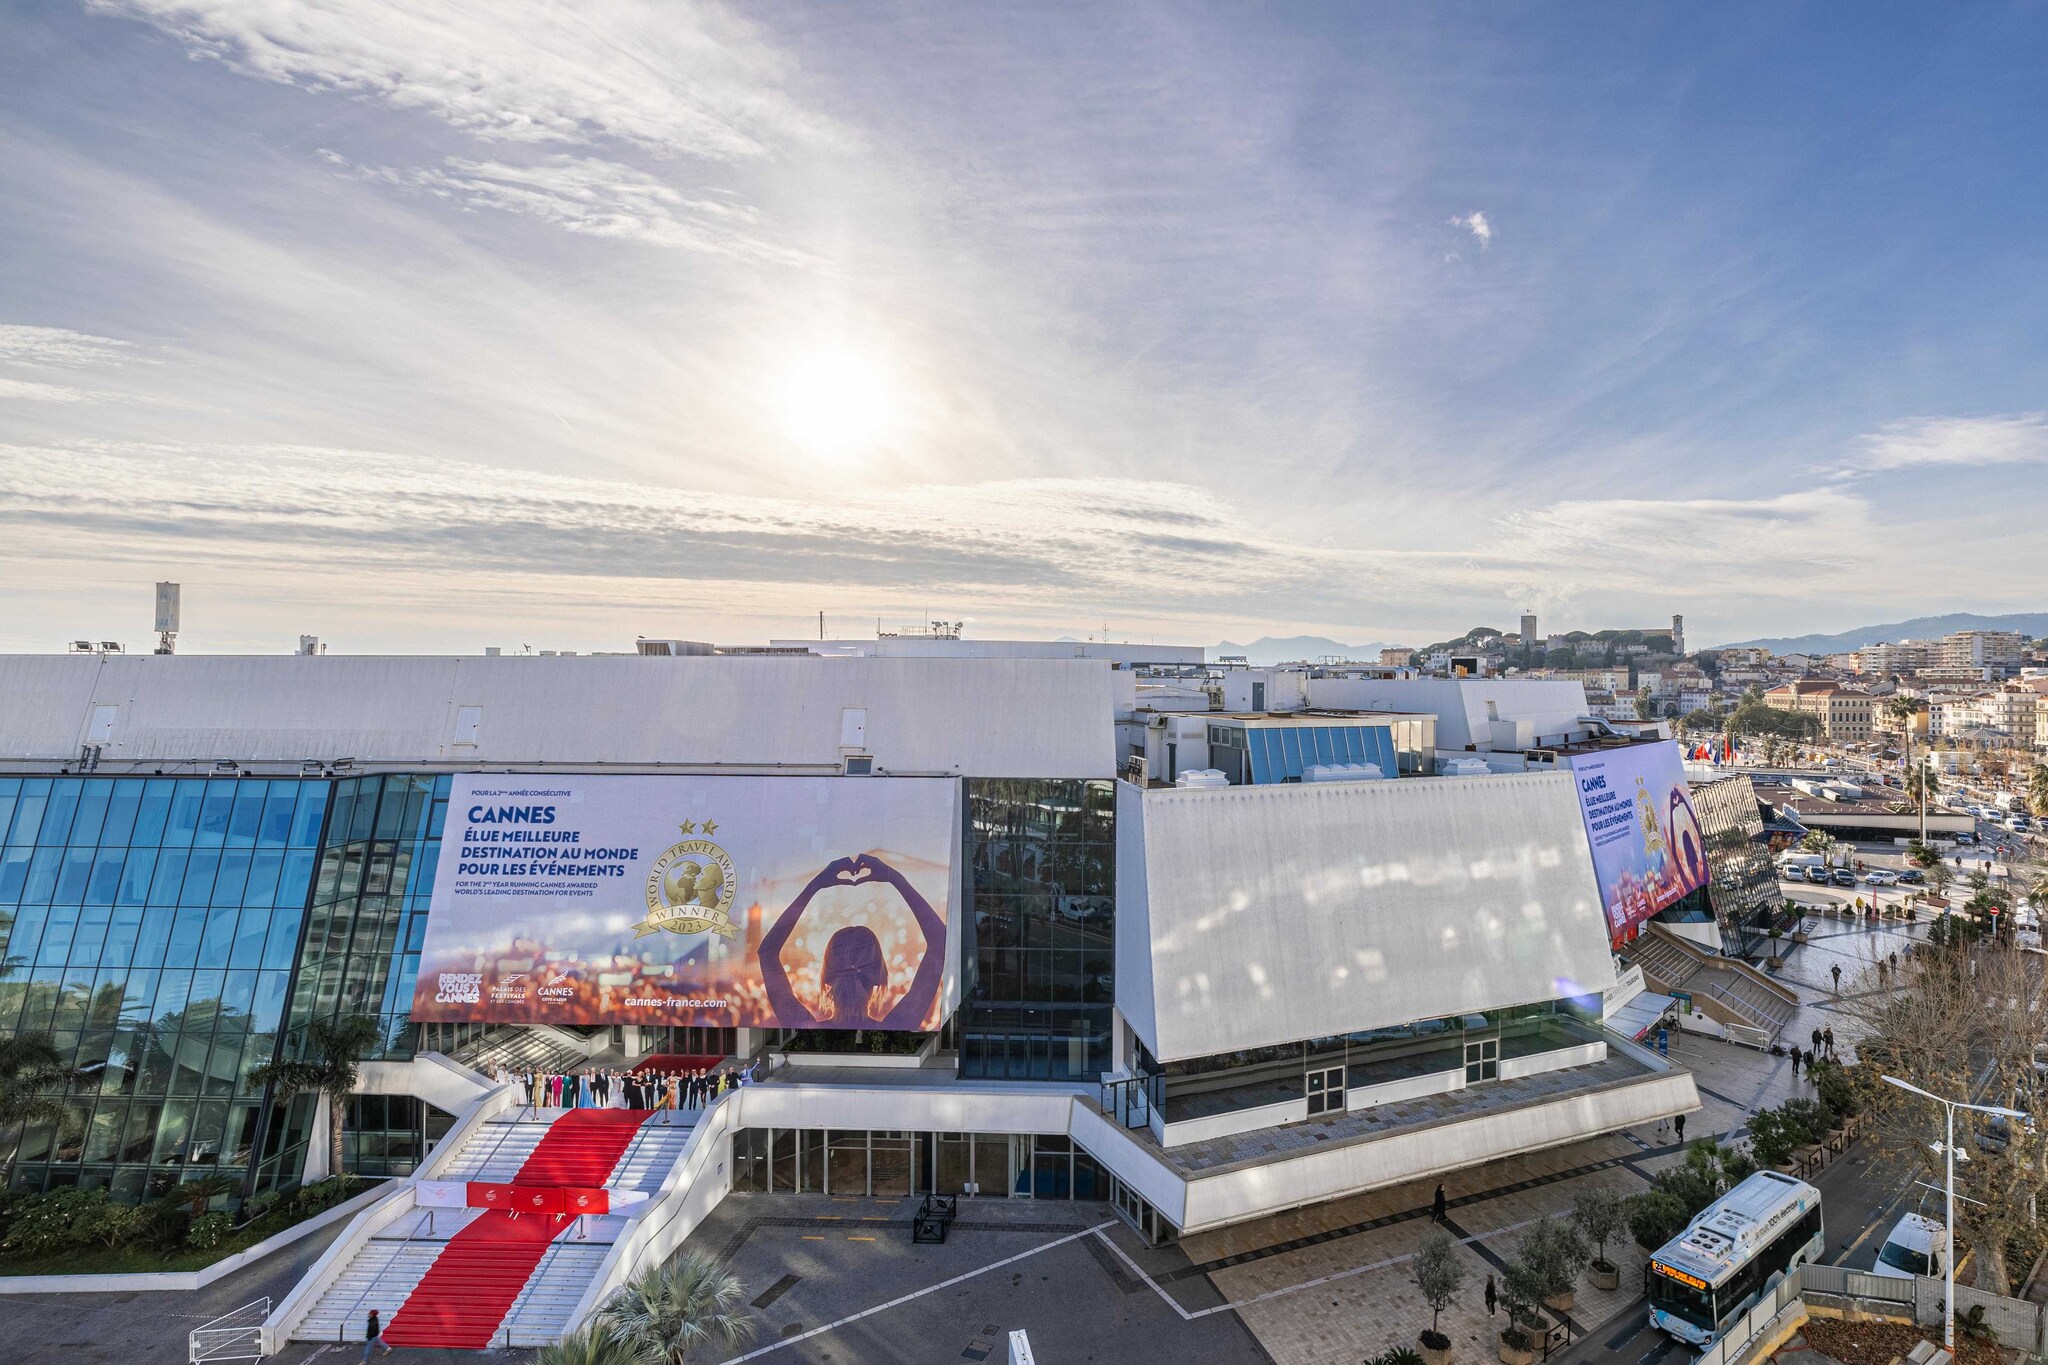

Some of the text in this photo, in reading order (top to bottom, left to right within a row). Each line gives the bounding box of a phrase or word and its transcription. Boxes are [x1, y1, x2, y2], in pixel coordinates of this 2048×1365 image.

[1582, 775, 1606, 792] CANNES
[529, 789, 571, 797] CONSÉCUTIVE
[1585, 791, 1617, 807] ÉLUE MEILLEURE
[468, 805, 556, 824] CANNES
[1588, 798, 1633, 819] DESTINATION AU MONDE
[1591, 820, 1604, 832] POUR
[1609, 811, 1634, 826] ÉVÉNEMENTS
[464, 827, 580, 843] ÉLUE MEILLEURE
[461, 847, 639, 860] DESTINATION AU MONDE
[458, 860, 625, 876] POUR LES ÉVÉNEMENTS
[648, 842, 735, 908] WORLD TRAVEL AWARDS
[656, 906, 720, 922] WINNER
[670, 920, 702, 932] 2023
[439, 973, 483, 984] RENDEZ
[1626, 974, 1640, 987] TOURISME
[440, 983, 470, 993] VOUS
[537, 987, 574, 996] CANNES
[435, 993, 480, 1003] CANNES
[624, 997, 727, 1008] cannes-france.com
[1768, 1213, 1781, 1227] 100%
